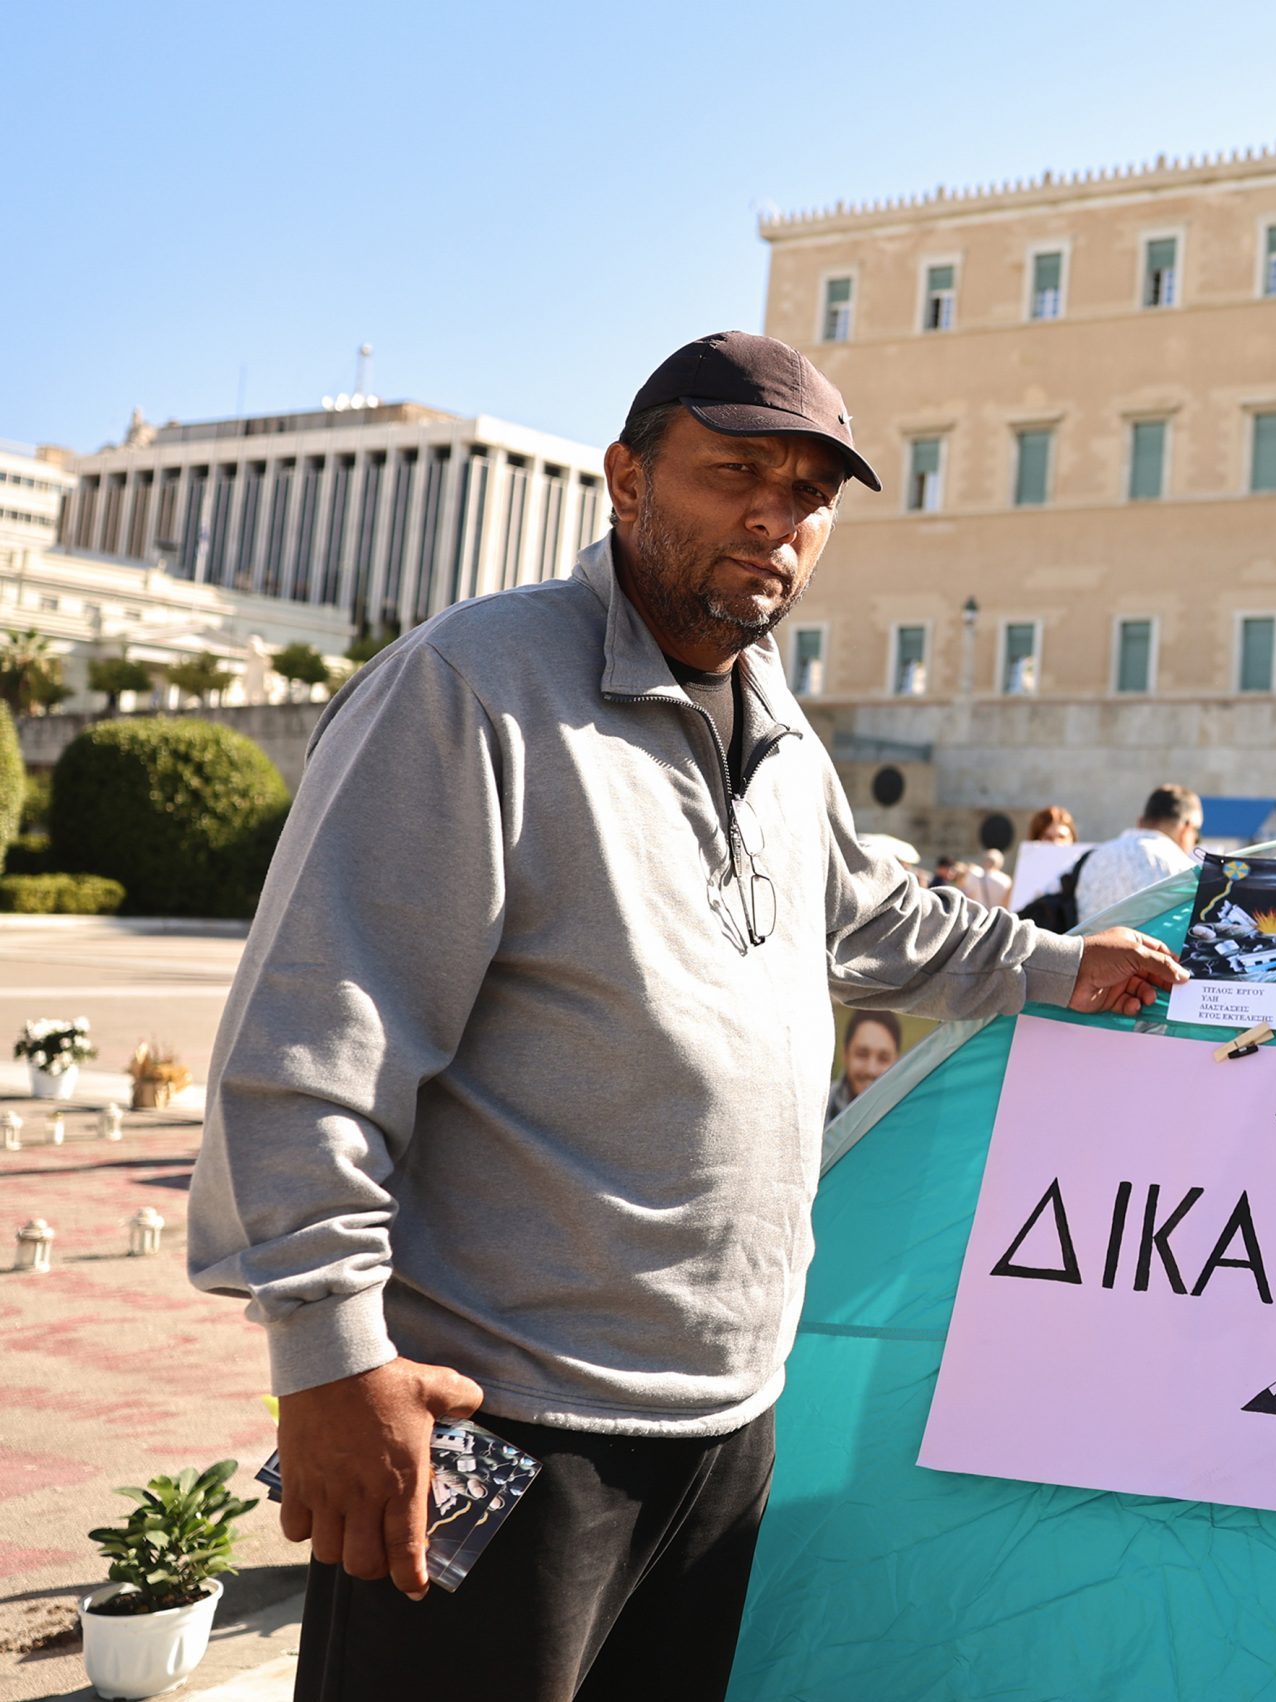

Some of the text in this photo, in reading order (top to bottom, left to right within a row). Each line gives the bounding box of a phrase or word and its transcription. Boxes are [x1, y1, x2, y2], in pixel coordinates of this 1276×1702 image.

[1203, 986, 1233, 995] ΤΙΤΛΟΣ
[1236, 988, 1264, 996] ΕΡΓΟΥ
[1201, 994, 1219, 1002] ΥΛΗ
[1200, 1003, 1250, 1012] ΔΙΑΣΤΑΣΕΙΣ
[1198, 1011, 1221, 1020] ΕΤΟΣ
[1222, 1013, 1273, 1023] ΕΚΤΕΛΕΣΗΣ
